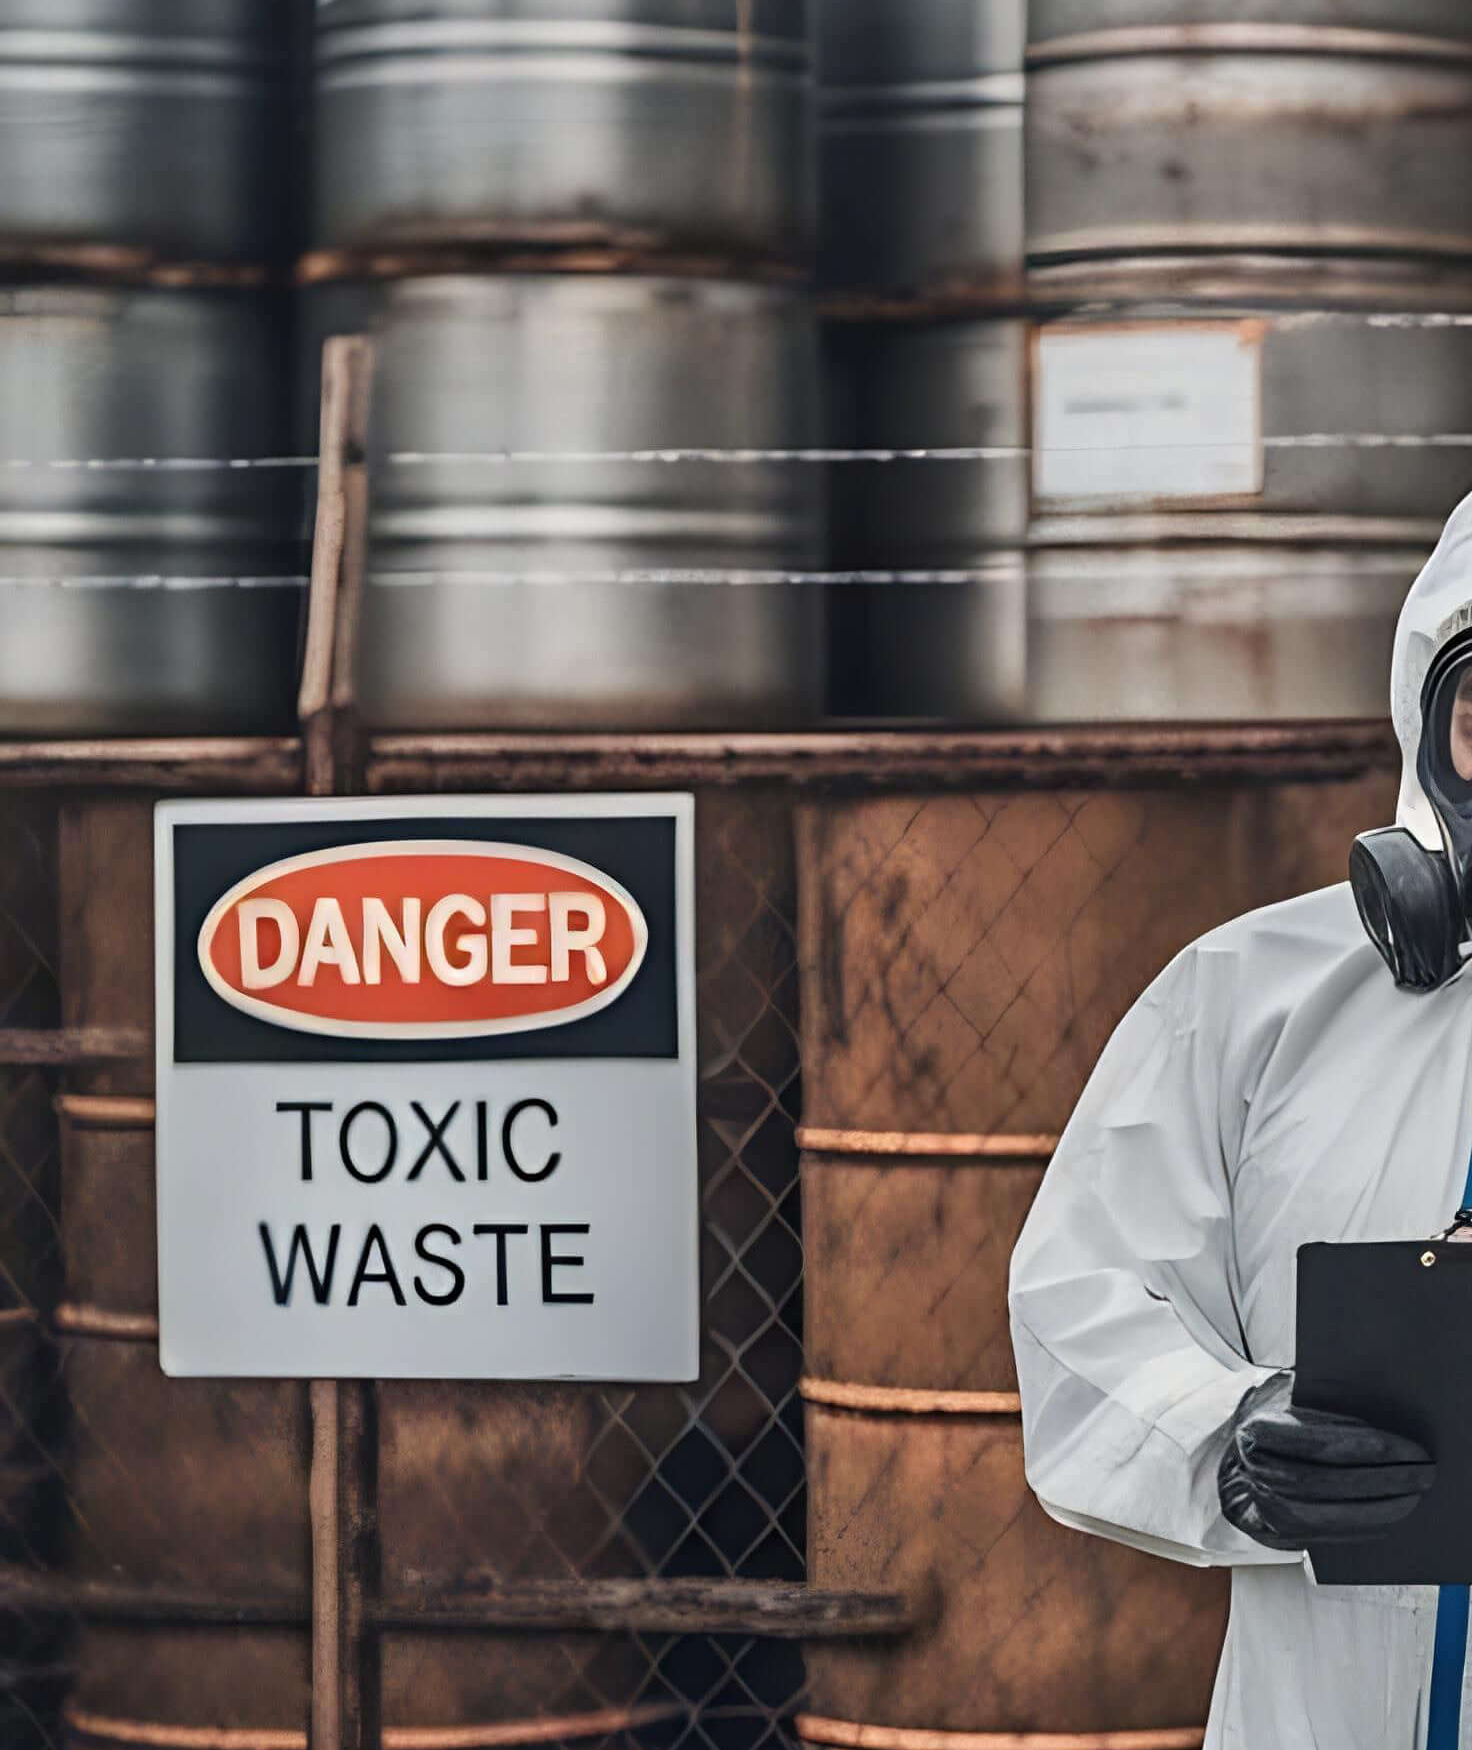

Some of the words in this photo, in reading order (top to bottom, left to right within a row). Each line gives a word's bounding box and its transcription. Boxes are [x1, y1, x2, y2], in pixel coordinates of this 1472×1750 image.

[237, 892, 608, 990] DANGER
[276, 1098, 562, 1183] TOXIC
[259, 1221, 595, 1308] WASTE
